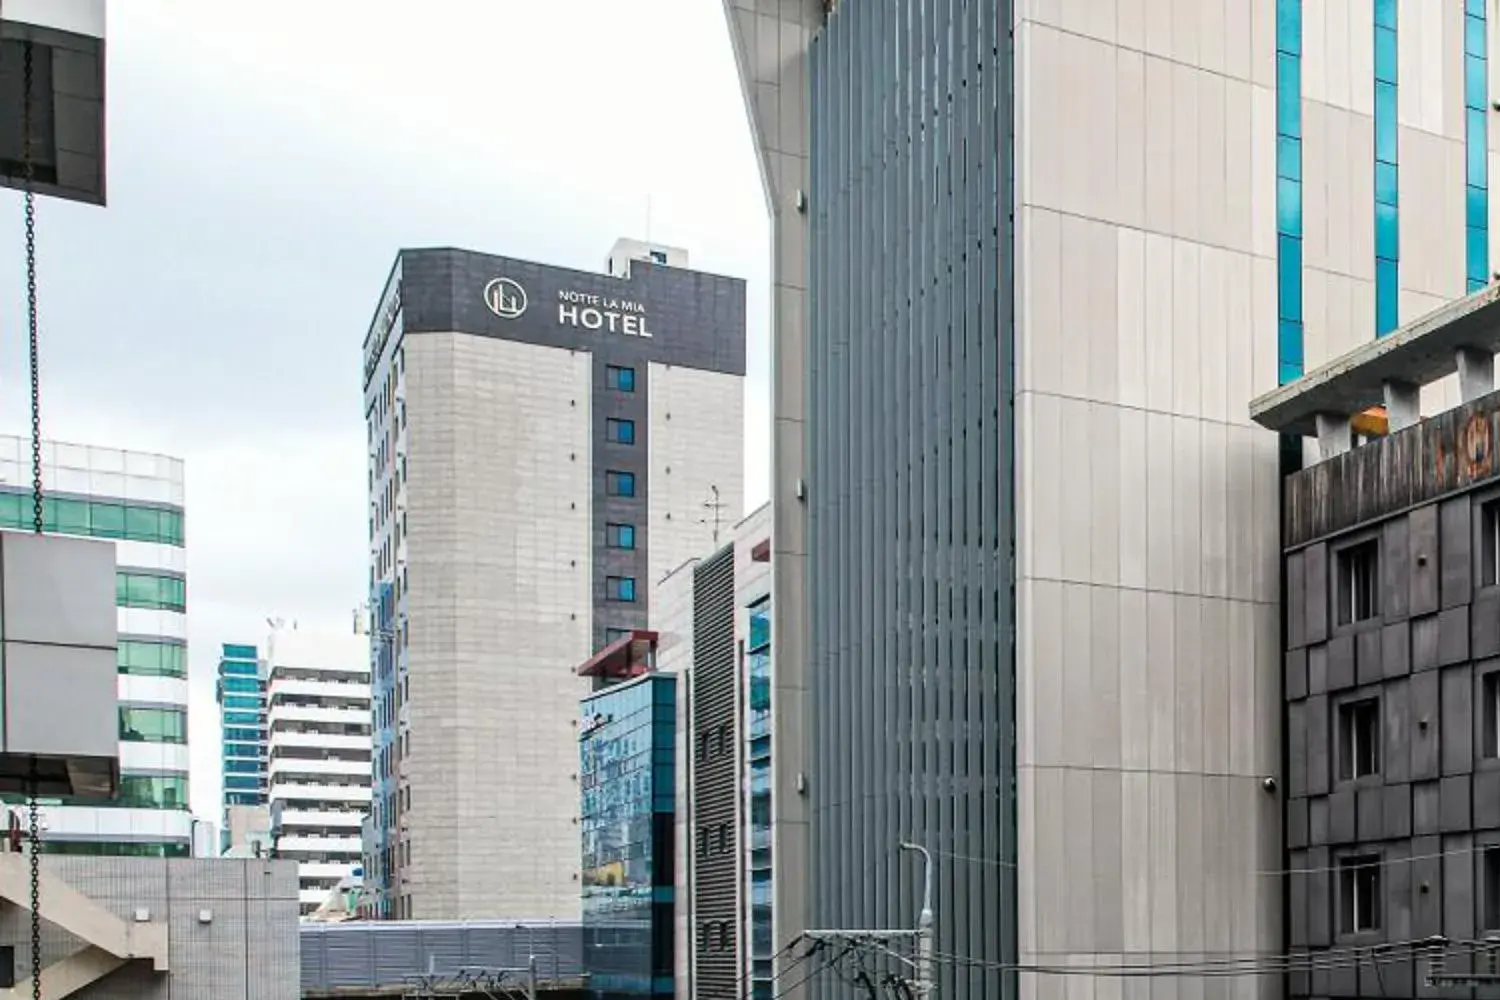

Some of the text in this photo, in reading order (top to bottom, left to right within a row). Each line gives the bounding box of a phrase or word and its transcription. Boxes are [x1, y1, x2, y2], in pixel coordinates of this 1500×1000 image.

[559, 290, 645, 313] NOTTE LA MIA
[558, 303, 653, 338] HOTEL
